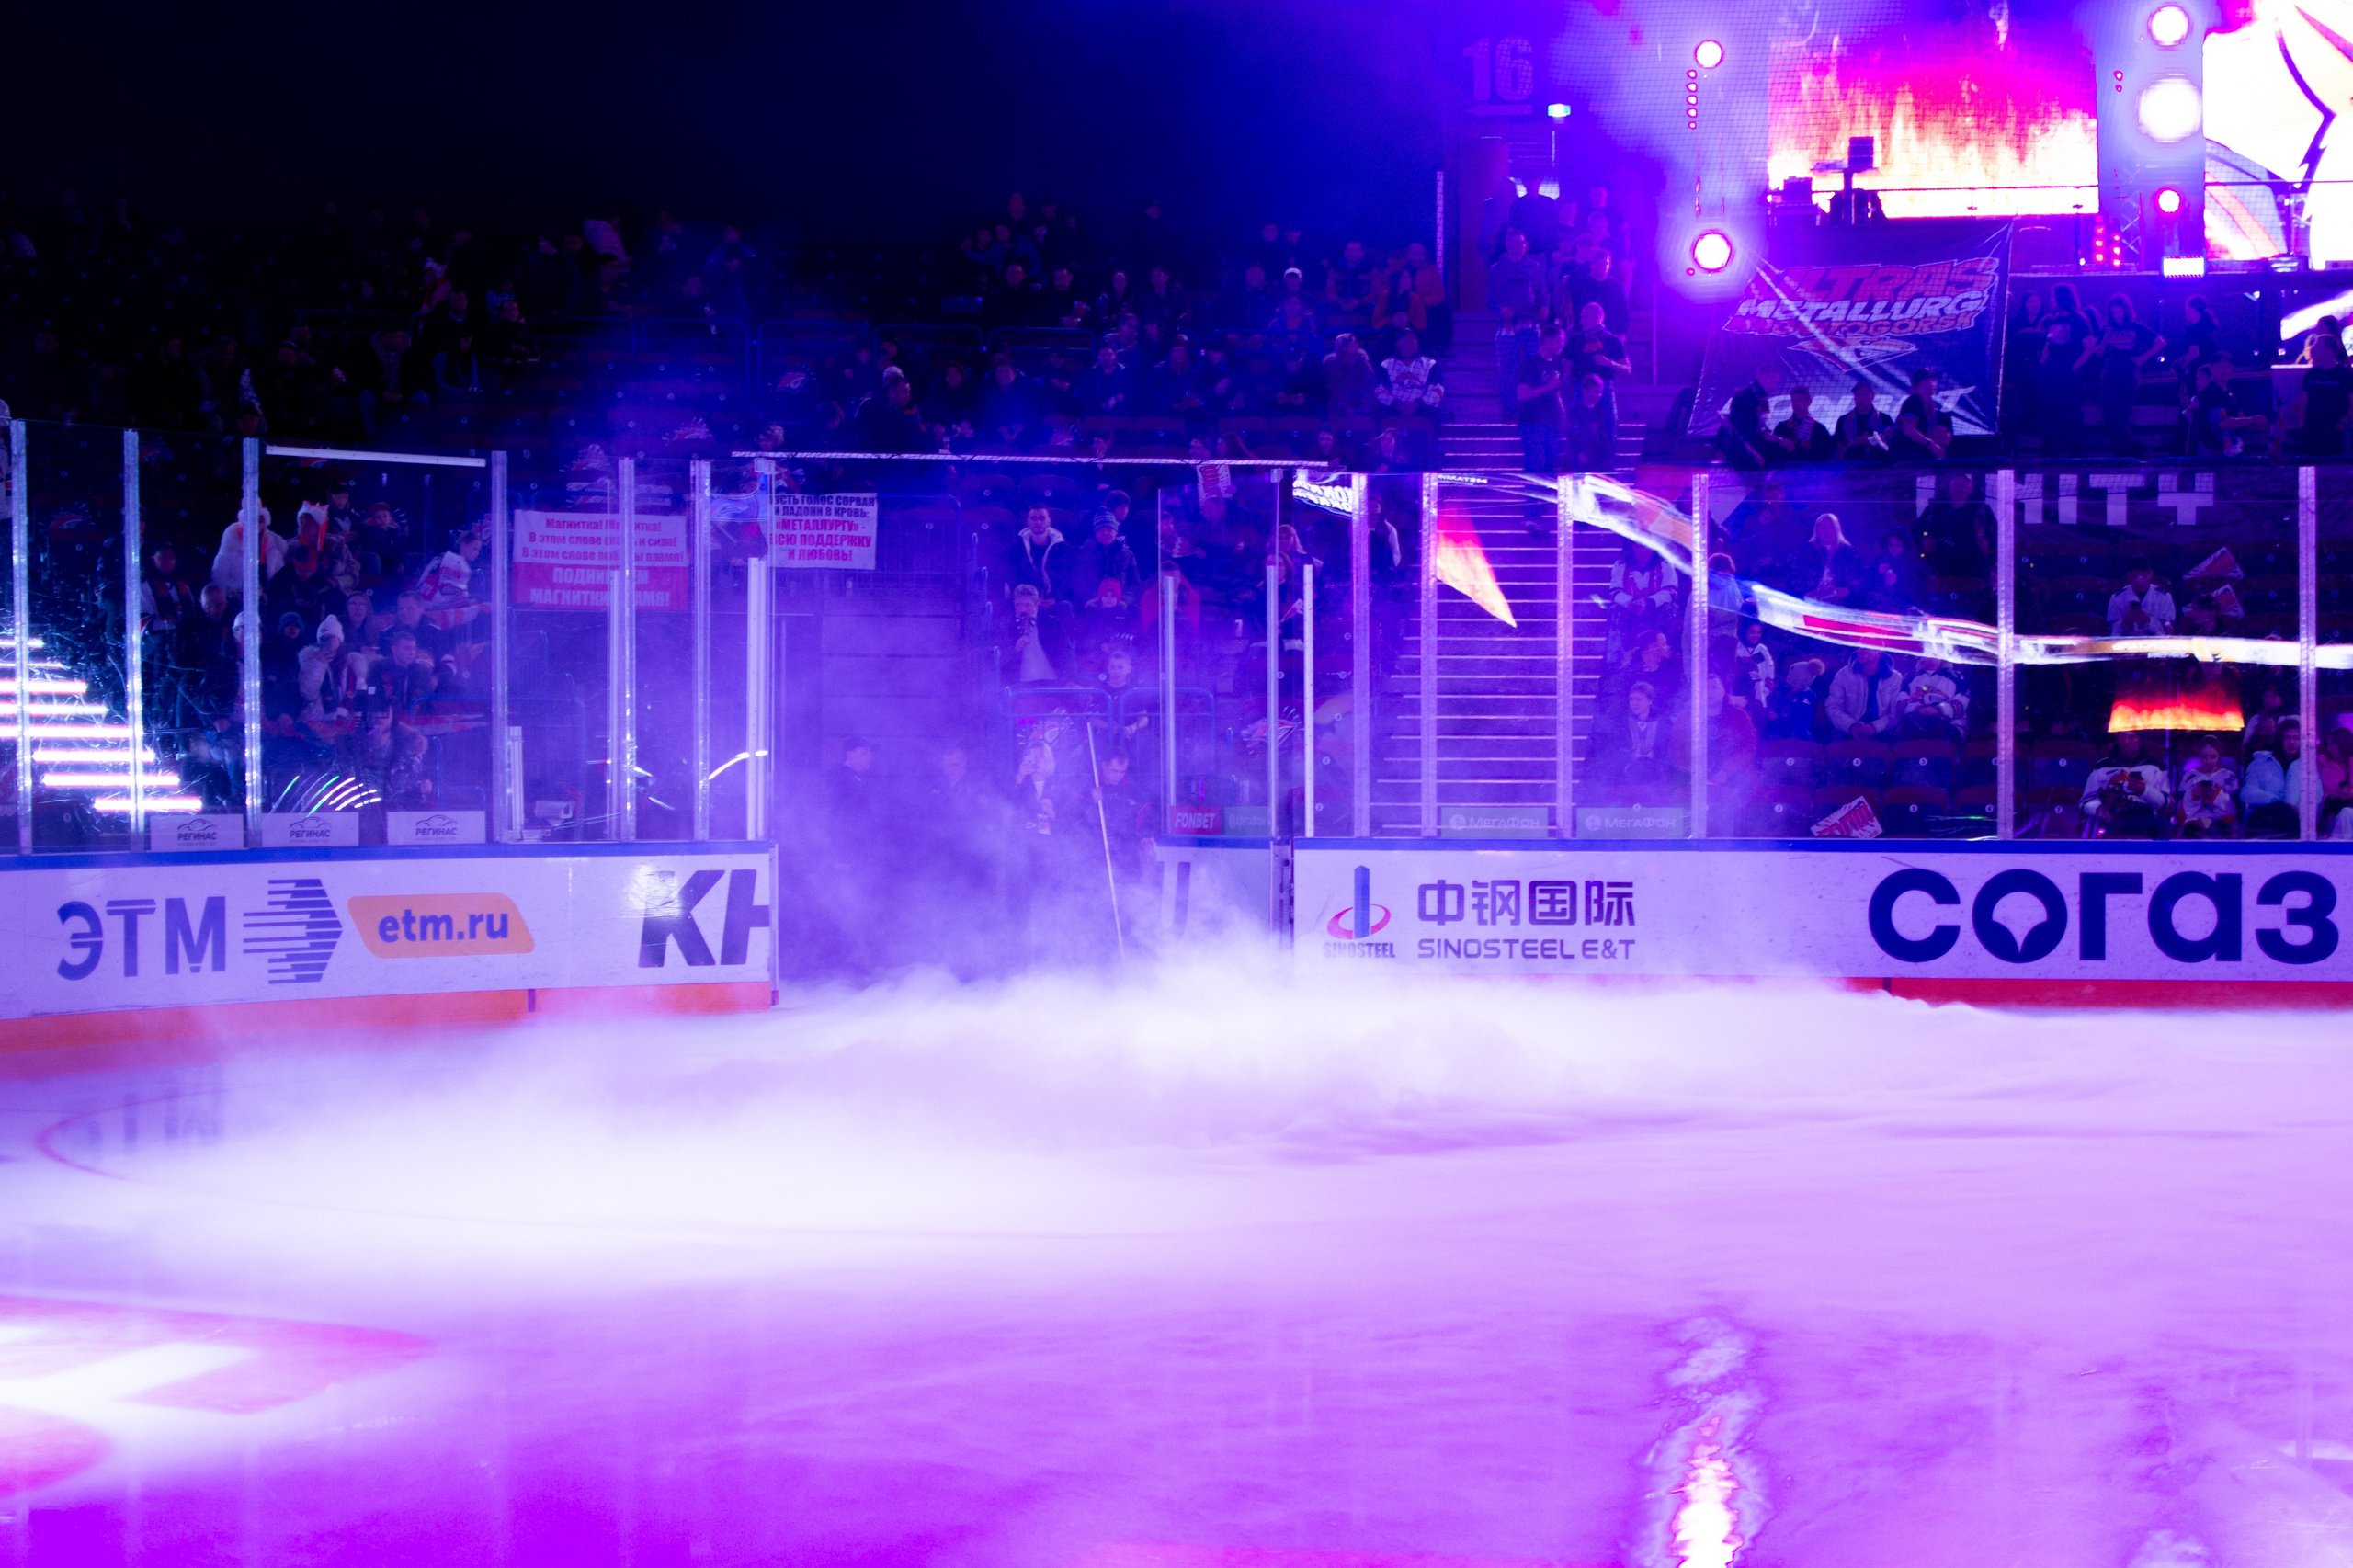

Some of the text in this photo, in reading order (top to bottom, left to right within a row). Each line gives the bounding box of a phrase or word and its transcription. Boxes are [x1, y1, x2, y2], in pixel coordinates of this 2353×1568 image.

[1462, 37, 1533, 102] 16
[1750, 258, 1998, 303] ULTRAS
[1735, 290, 1988, 324] METALLURG
[801, 494, 834, 506] ГОЛОС
[782, 506, 823, 517] ЛАДОНИ
[825, 506, 832, 517] В
[835, 507, 870, 518] КРОВЬ:
[545, 517, 661, 531] Магнитка! Маитка!
[529, 531, 536, 543] В
[539, 534, 566, 545] этом
[568, 536, 602, 546] слове
[647, 536, 677, 547] сила!
[800, 534, 872, 548] ПОДДЕРЖКУ
[521, 546, 529, 558] В
[531, 549, 560, 560] этом
[562, 551, 596, 561] слове
[788, 549, 854, 562] И ЛЮБОВЬ!
[1176, 812, 1216, 830] FONBET
[176, 832, 218, 841] РЕГИНАС
[289, 829, 331, 839] РЕГИНАС
[415, 827, 458, 836] РЕГИНАС
[1417, 879, 1636, 926] 中钢国际
[378, 907, 509, 944] etm.ru
[57, 896, 226, 980] ЭТМ
[1323, 941, 1396, 959] SINOSTEEL
[1417, 938, 1636, 959] SINOSTEEL E&T
